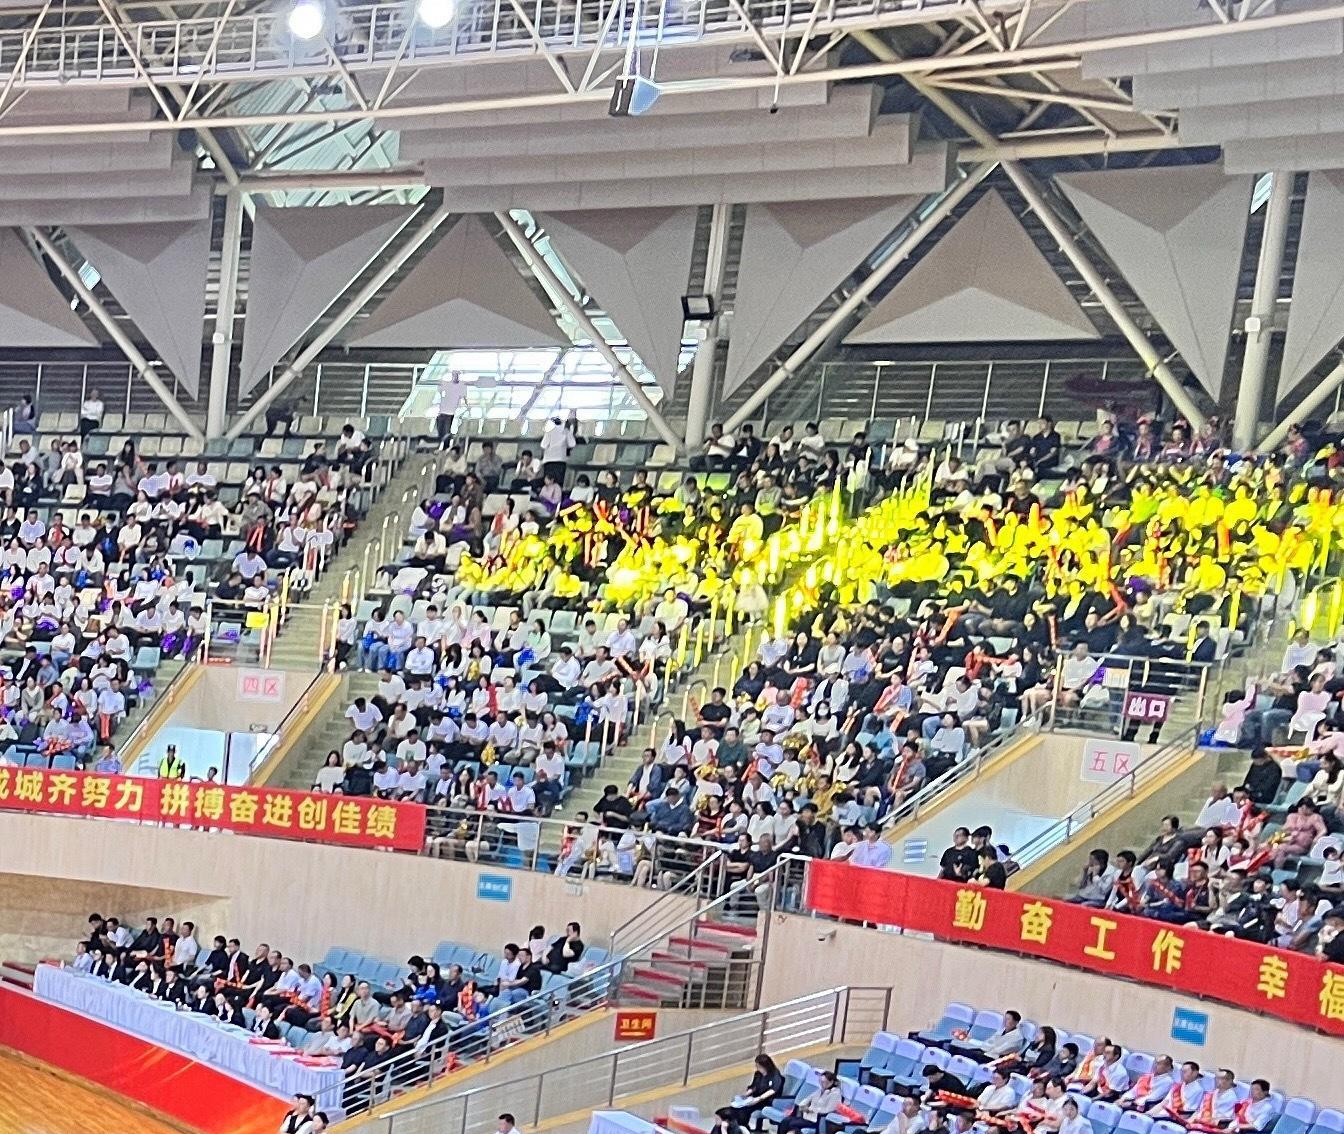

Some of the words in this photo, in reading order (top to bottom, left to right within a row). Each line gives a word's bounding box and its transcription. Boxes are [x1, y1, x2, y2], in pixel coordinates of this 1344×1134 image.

[243, 675, 280, 696] 四区
[1128, 696, 1166, 718] 出口
[1088, 750, 1131, 775] 五区
[160, 783, 397, 839] 拼搏奋进创佳绩
[952, 888, 1185, 976] 勤奋工作
